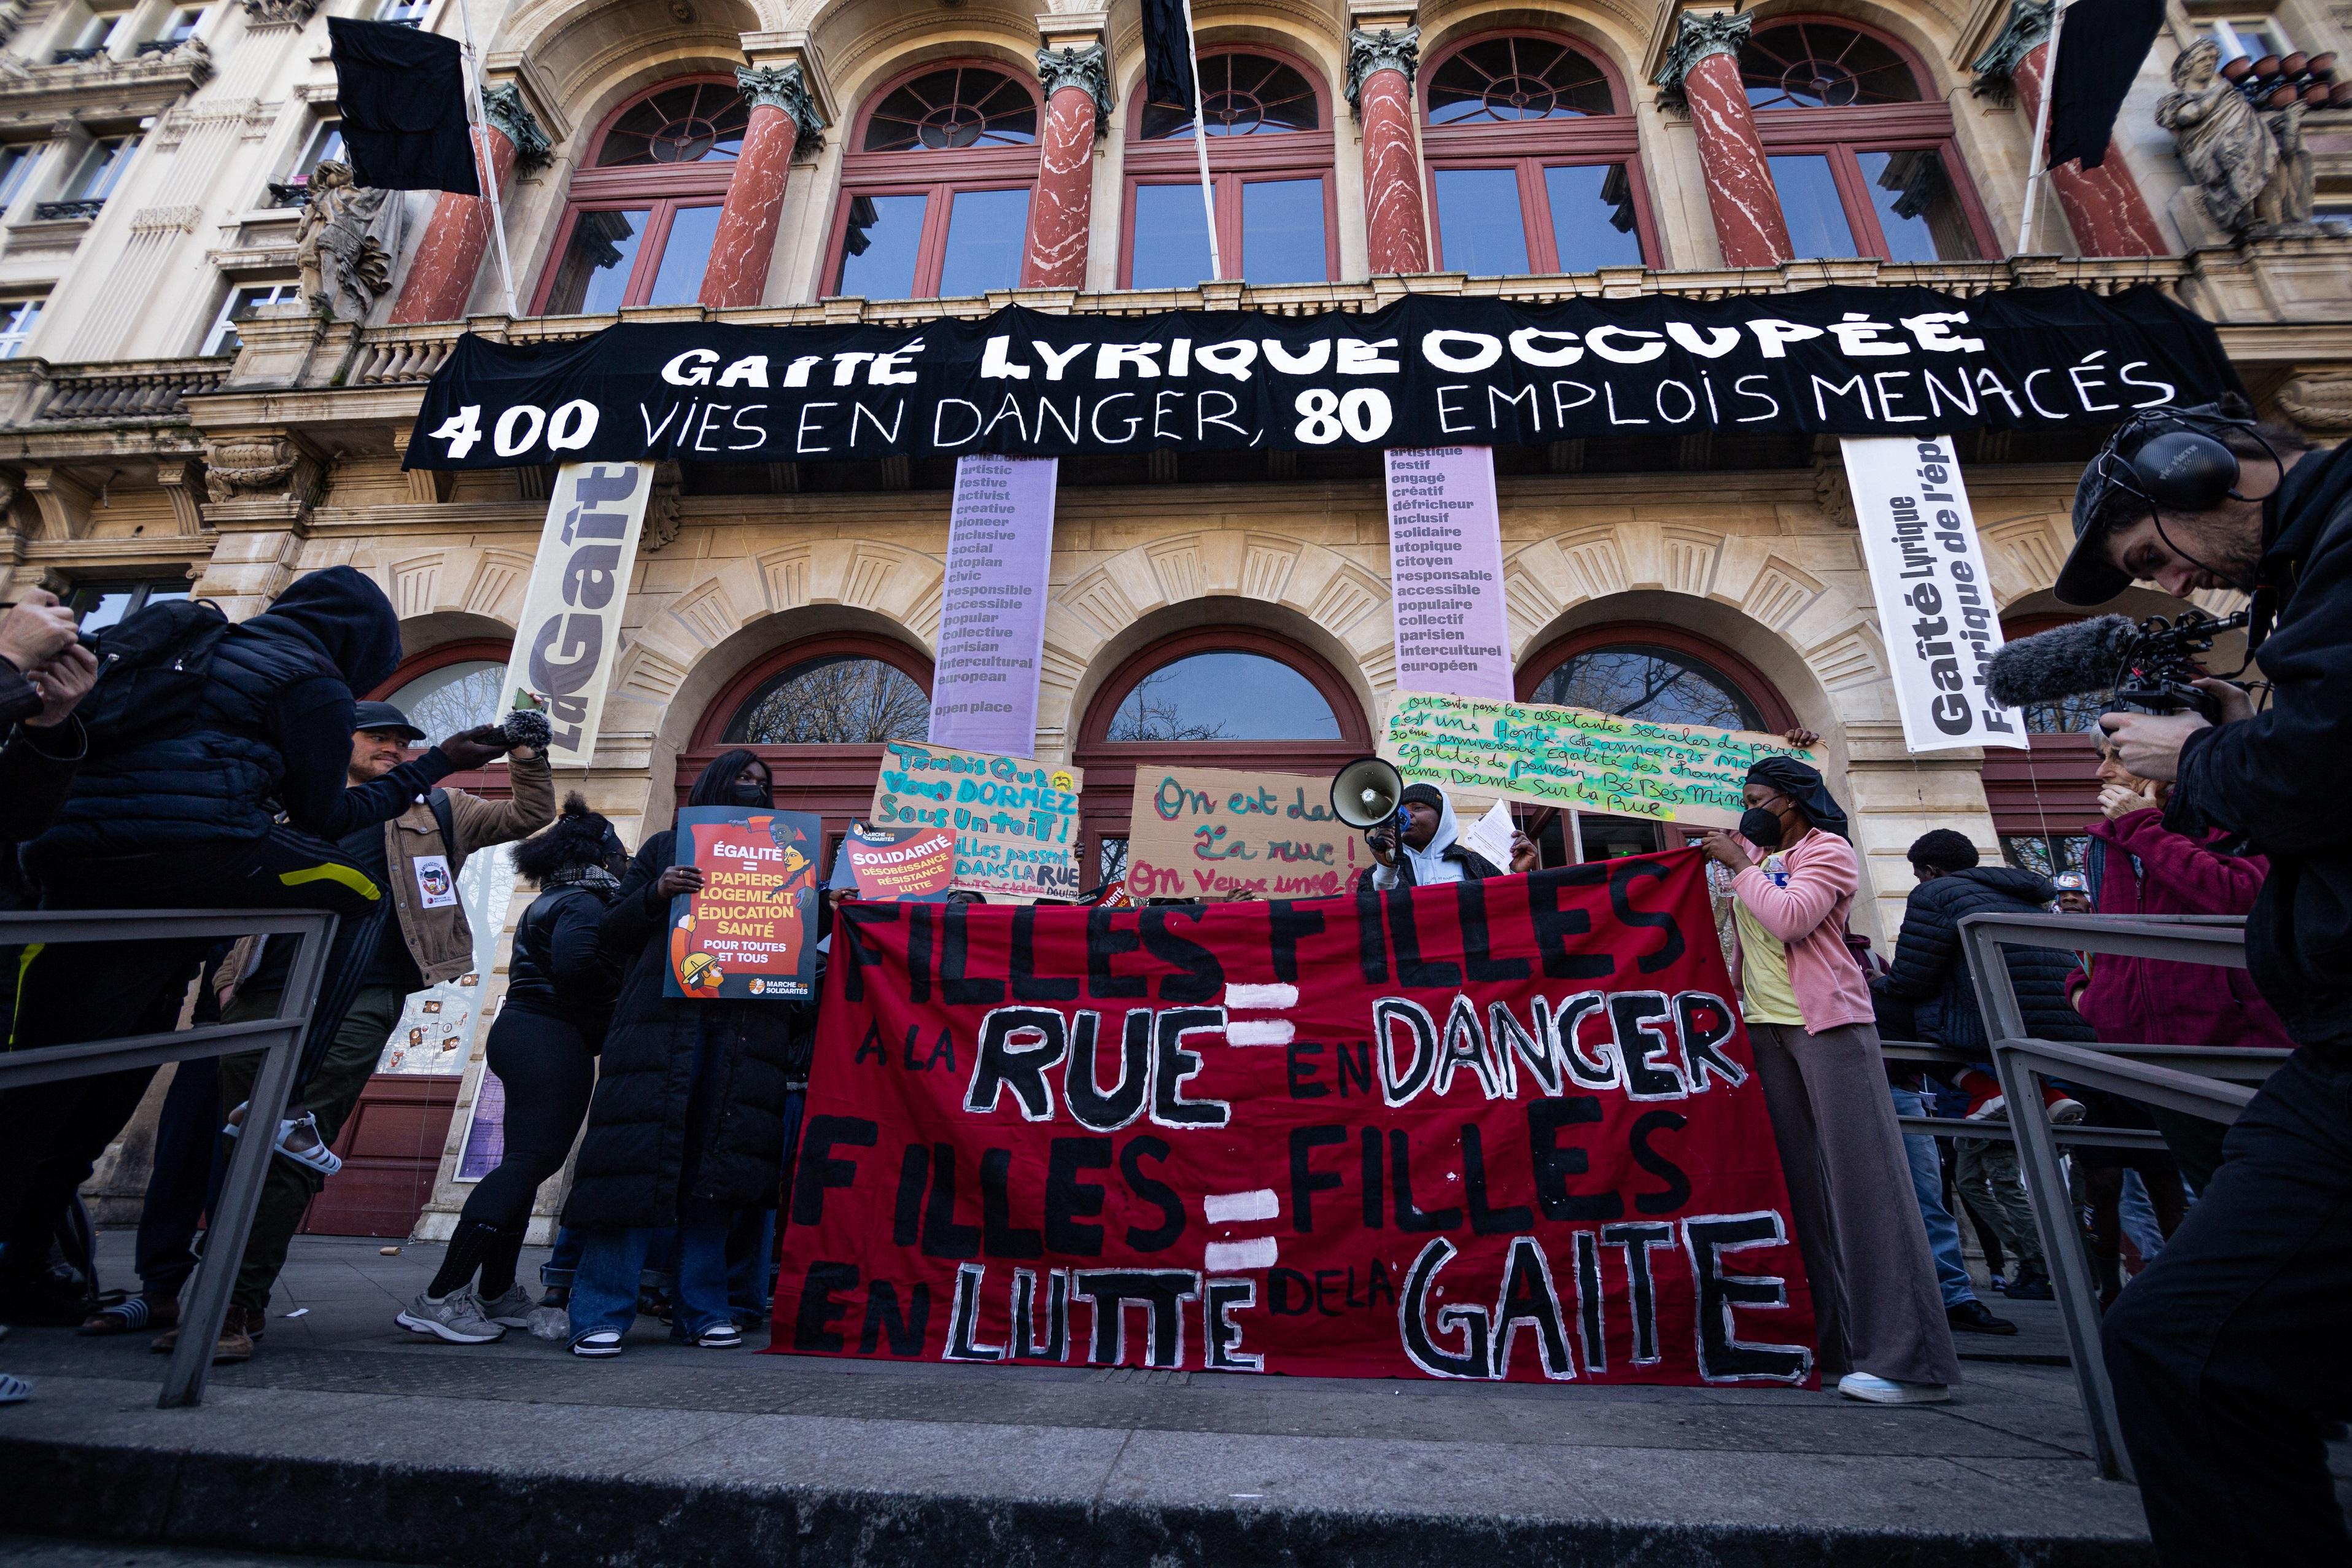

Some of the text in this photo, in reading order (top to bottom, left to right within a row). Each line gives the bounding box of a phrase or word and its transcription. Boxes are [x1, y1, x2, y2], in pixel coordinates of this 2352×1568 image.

[981, 335, 1400, 381] LYRIQUE
[1422, 311, 1984, 373] OCCUPÉE
[428, 350, 2175, 459] 400 VIES EN DANGER, 80 EMPLOIS MENACÉS
[1390, 447, 1462, 457] artistique
[961, 464, 1012, 475] artistic
[1391, 460, 1430, 470] festif
[960, 478, 1007, 489] festive
[1391, 473, 1445, 484] engagé
[958, 491, 1011, 502] activist
[1392, 486, 1443, 498] créatif
[956, 503, 1015, 514] creative
[1393, 499, 1474, 511] défricheur
[954, 516, 1009, 530] pioneer
[1394, 513, 1449, 525] inclusif
[953, 530, 1015, 541] inclusive
[1394, 526, 1462, 539] solidaire
[1935, 508, 1968, 553] de
[952, 543, 993, 555] social
[1395, 541, 1462, 553] utopique
[950, 557, 1003, 569] utopian
[1395, 556, 1453, 567] citoyen
[949, 571, 982, 583] civic
[1397, 570, 1492, 582] responsable
[947, 584, 1032, 597] responsible
[1397, 584, 1481, 596] accessible
[945, 599, 1022, 611] accessible
[1398, 599, 1473, 613] populaire
[944, 612, 999, 627] popular
[1399, 614, 1464, 626] collectif
[1889, 495, 1973, 735] Gaîté Lyrique
[942, 627, 1013, 640] collective
[1400, 629, 1465, 643] parisien
[941, 641, 999, 657] parisian
[1400, 645, 1502, 656] interculturel
[939, 656, 1033, 670] intercultural
[1401, 660, 1478, 673] européen
[937, 672, 1007, 685] european
[935, 701, 1012, 716] open place
[1437, 715, 1479, 732] une
[1663, 746, 1709, 762] 2025
[1534, 710, 1624, 731] assistantes
[1717, 735, 1741, 751] de
[1750, 742, 1807, 763] paris
[1438, 733, 1536, 756] anniverssaire
[1631, 756, 1661, 774] des
[1488, 753, 1507, 769] de
[1515, 759, 1586, 780] pouvoir
[957, 778, 1077, 816] DORMEZ
[1154, 775, 1217, 821] On
[1228, 786, 1278, 816] est
[878, 794, 949, 828] Sous
[953, 807, 988, 833] Un
[713, 840, 783, 861] ÉGALITÉ
[853, 834, 952, 865] SOLIDARITÉ
[1267, 840, 1335, 865] rue
[861, 852, 949, 875] DÉSOBÉISSANCE
[711, 872, 783, 887] PAPIERS
[877, 864, 945, 885] RÉSISTANCE
[955, 860, 1079, 887] DANS LA RUE
[1127, 860, 1185, 898] On
[899, 880, 933, 893] LUTTE
[700, 888, 794, 904] LOGEMENT
[698, 904, 794, 920] ÉDUCATION
[717, 920, 775, 937] SANTÉ
[845, 899, 1225, 1005] FILLES
[1269, 863, 1685, 987] FILLES
[704, 940, 786, 952] POUR TOUTES
[718, 952, 768, 963] ET TOUS
[904, 1024, 956, 1073] LA
[963, 1004, 1232, 1133] RUE
[1287, 1041, 1372, 1100] EN
[1373, 989, 1748, 1108] DANGER
[792, 1114, 1187, 1259] FILLES
[1288, 1095, 1691, 1236] FILLES
[793, 1260, 930, 1356] EN
[942, 1262, 1265, 1372] LUTTE
[1399, 1208, 1813, 1382] GAITE
